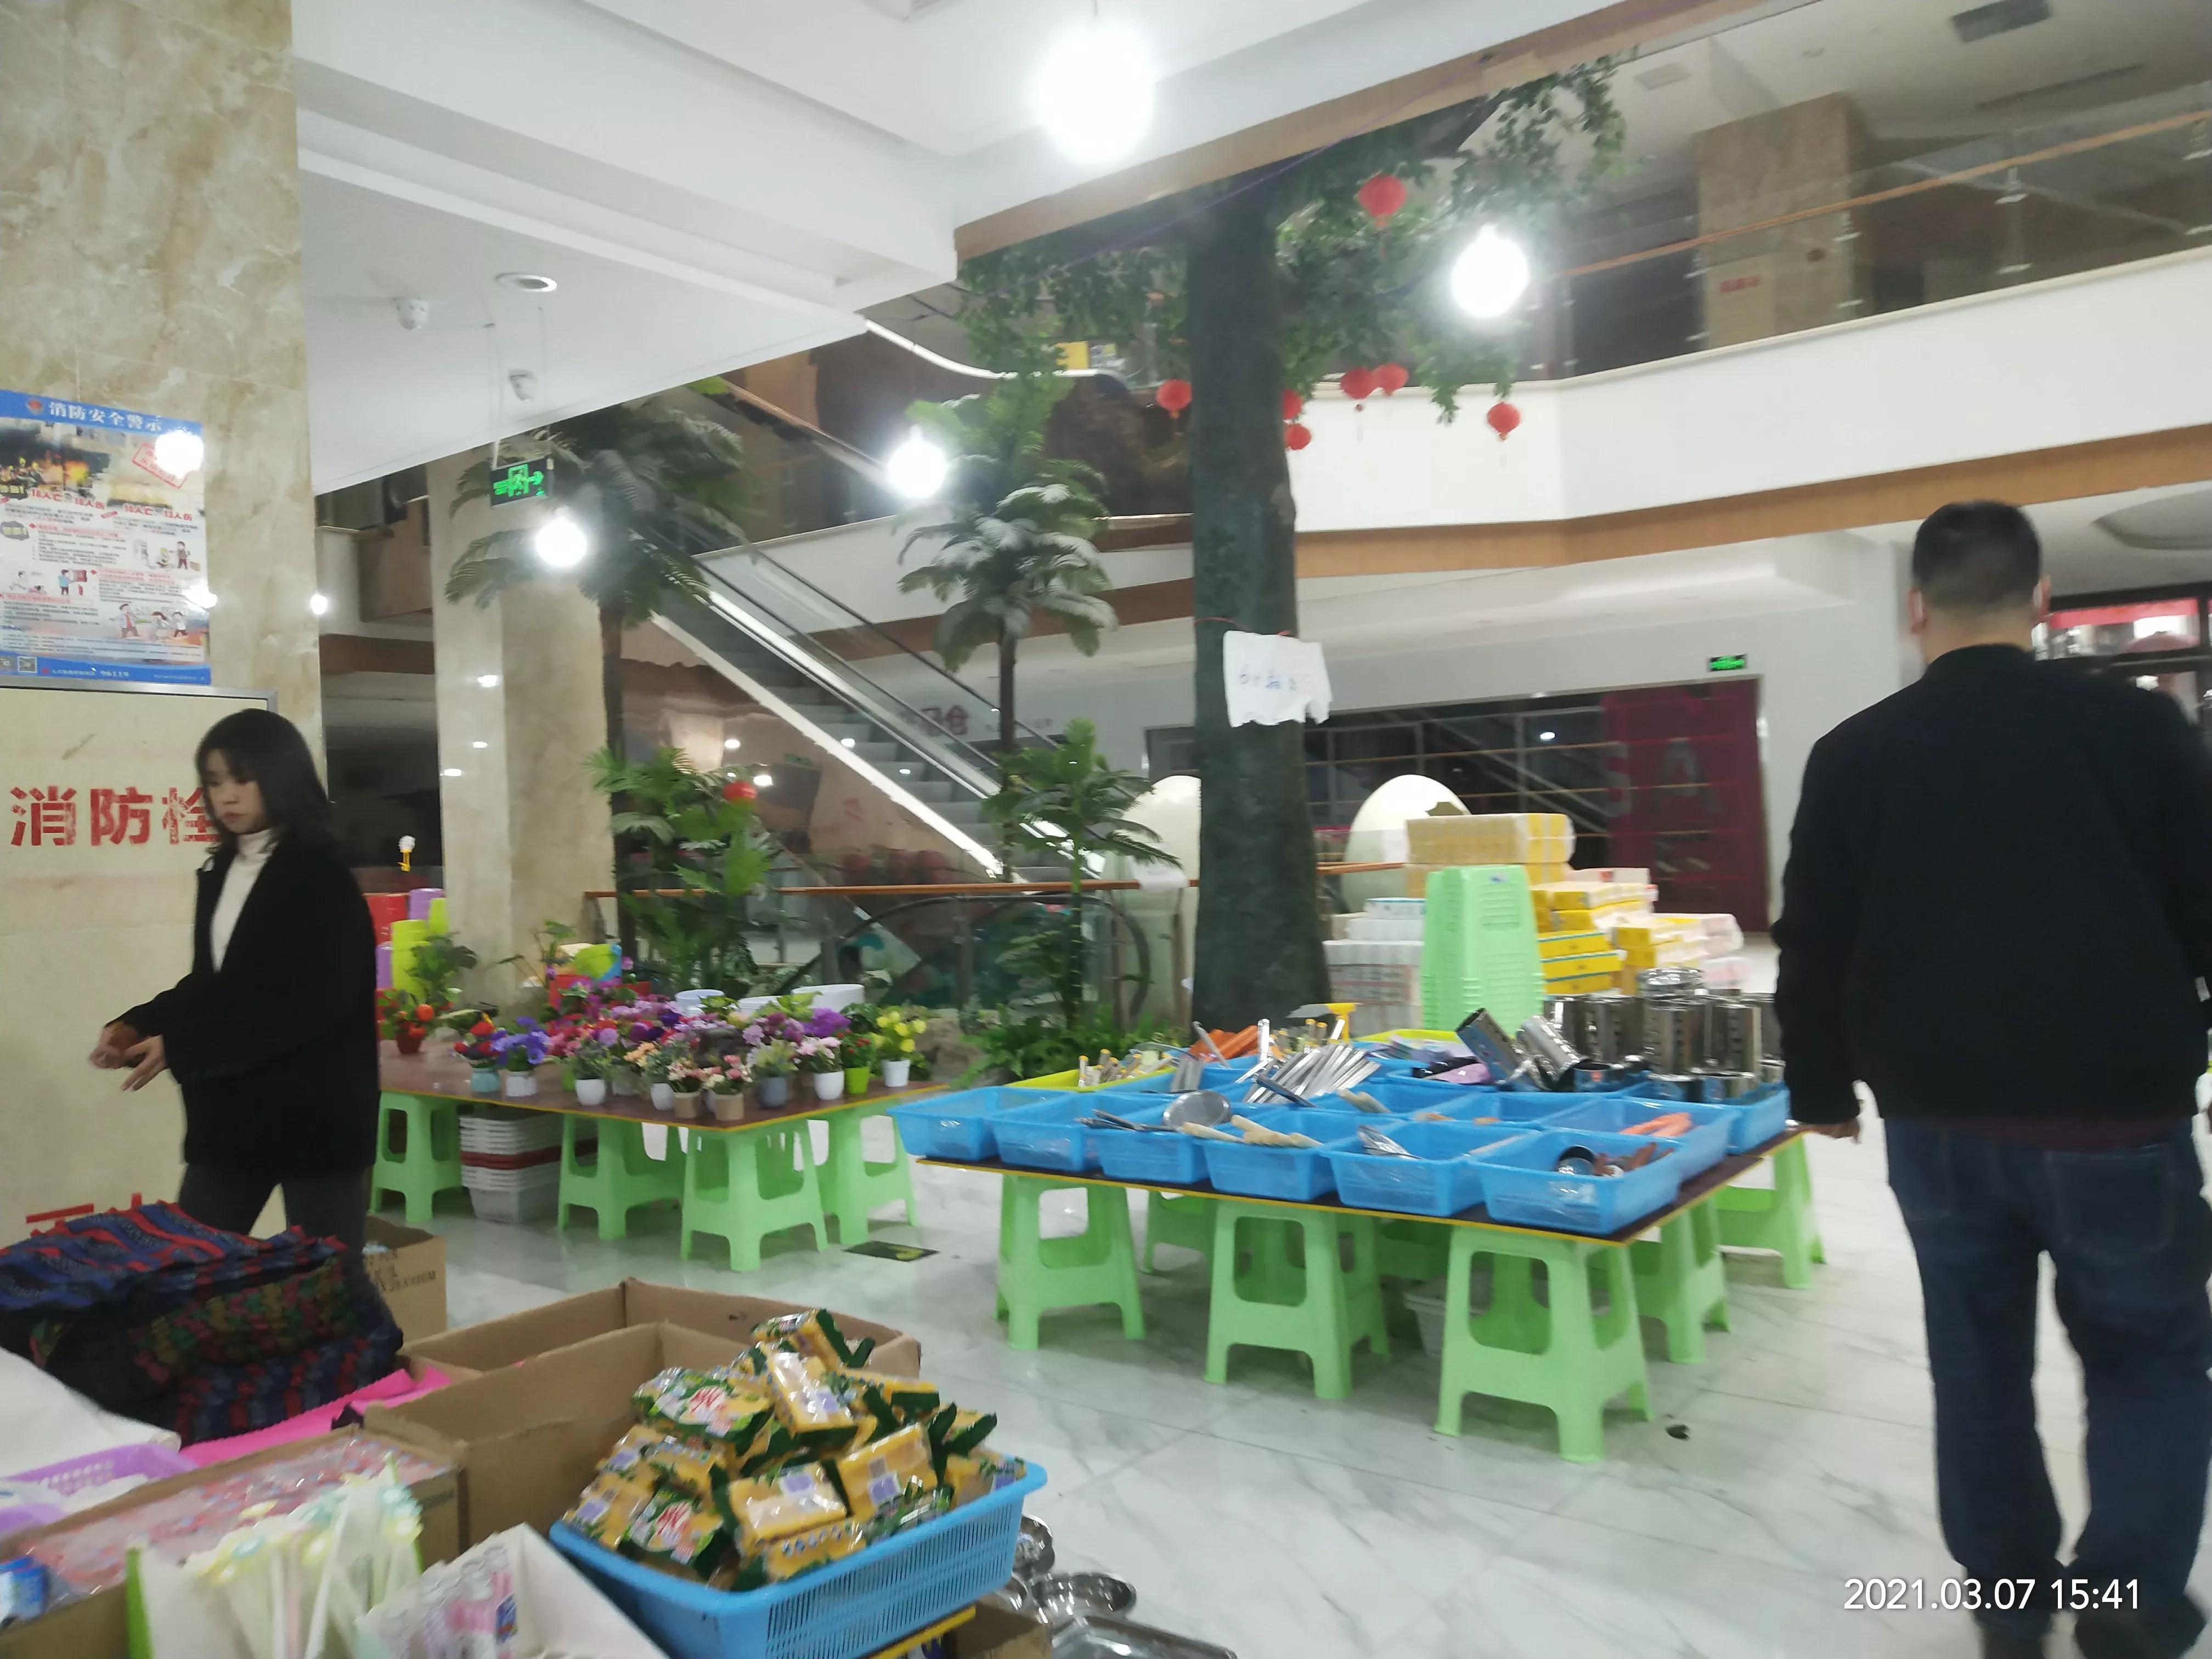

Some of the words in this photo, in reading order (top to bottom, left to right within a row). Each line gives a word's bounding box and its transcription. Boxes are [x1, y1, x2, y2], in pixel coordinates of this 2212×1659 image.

[48, 400, 163, 431] 消防安全警示
[10, 785, 221, 847] 消防栓
